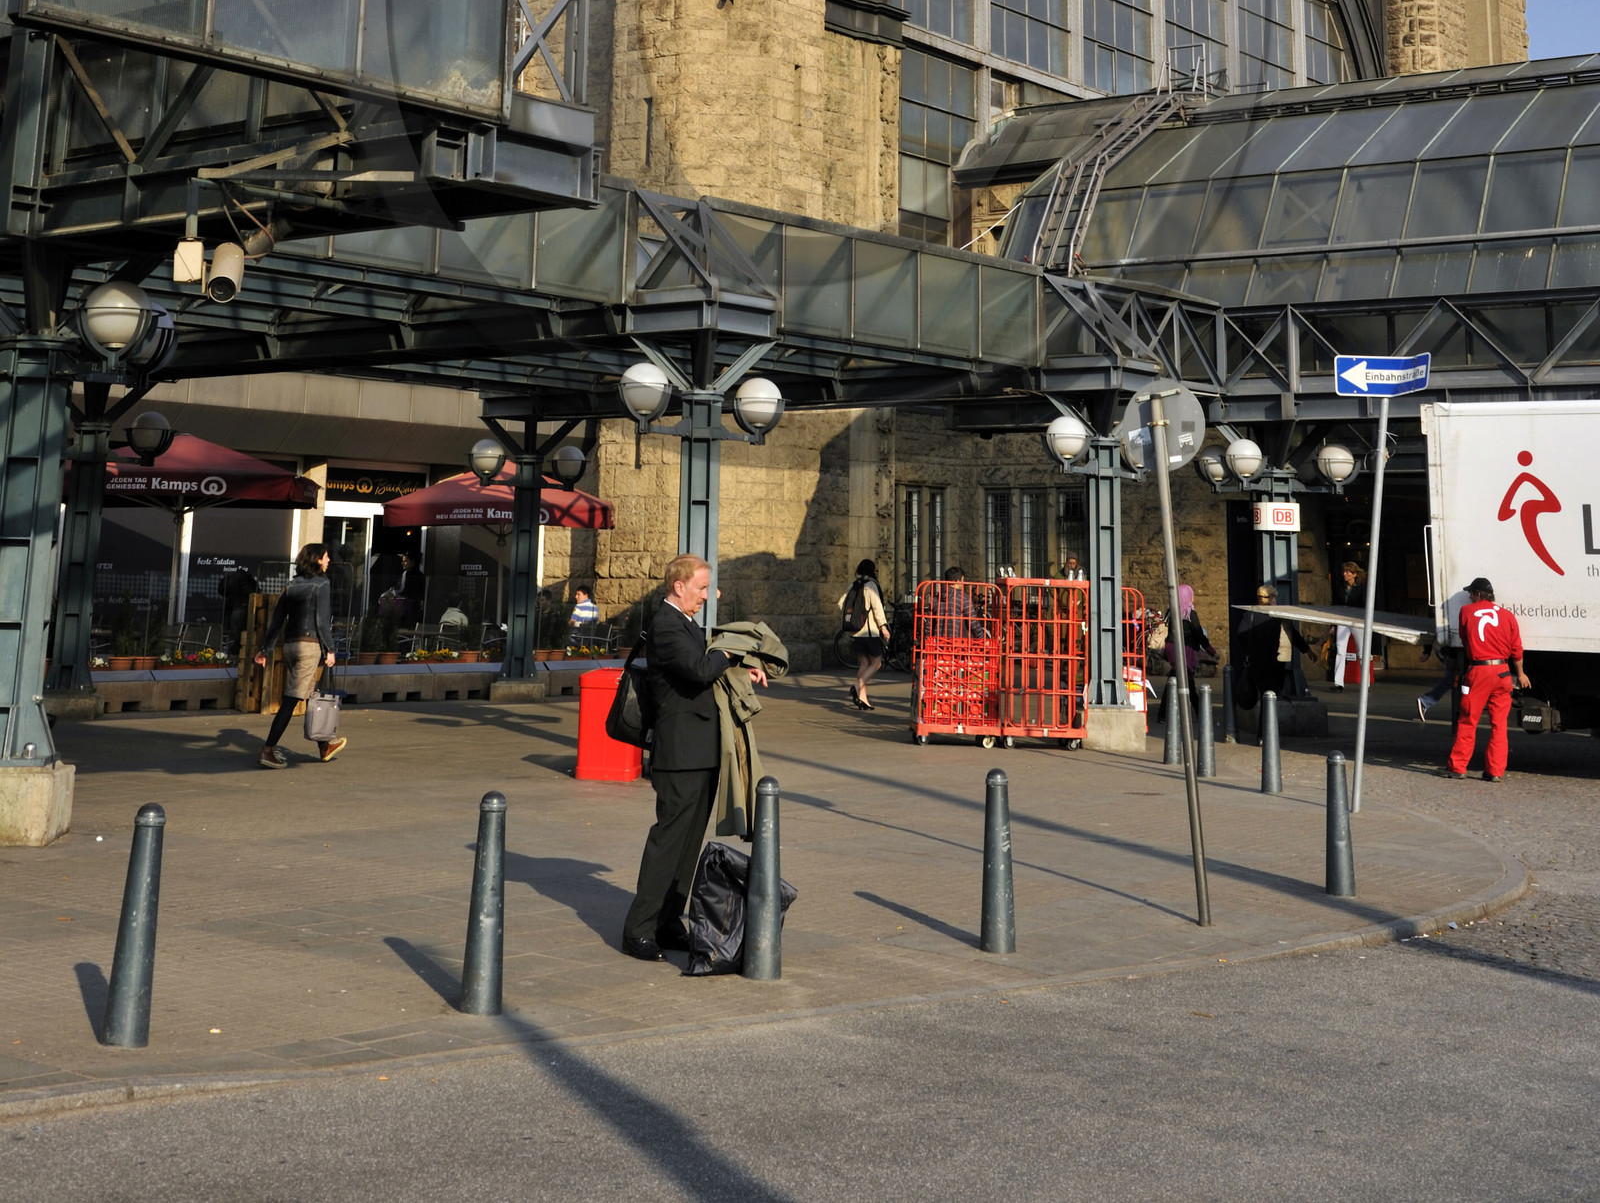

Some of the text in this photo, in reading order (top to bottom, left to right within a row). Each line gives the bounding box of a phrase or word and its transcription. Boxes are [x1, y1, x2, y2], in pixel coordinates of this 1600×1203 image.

[1365, 368, 1424, 381] Einbahnstraße
[151, 477, 198, 494] Kamps
[326, 479, 356, 492] amps
[1276, 511, 1292, 523] DB
